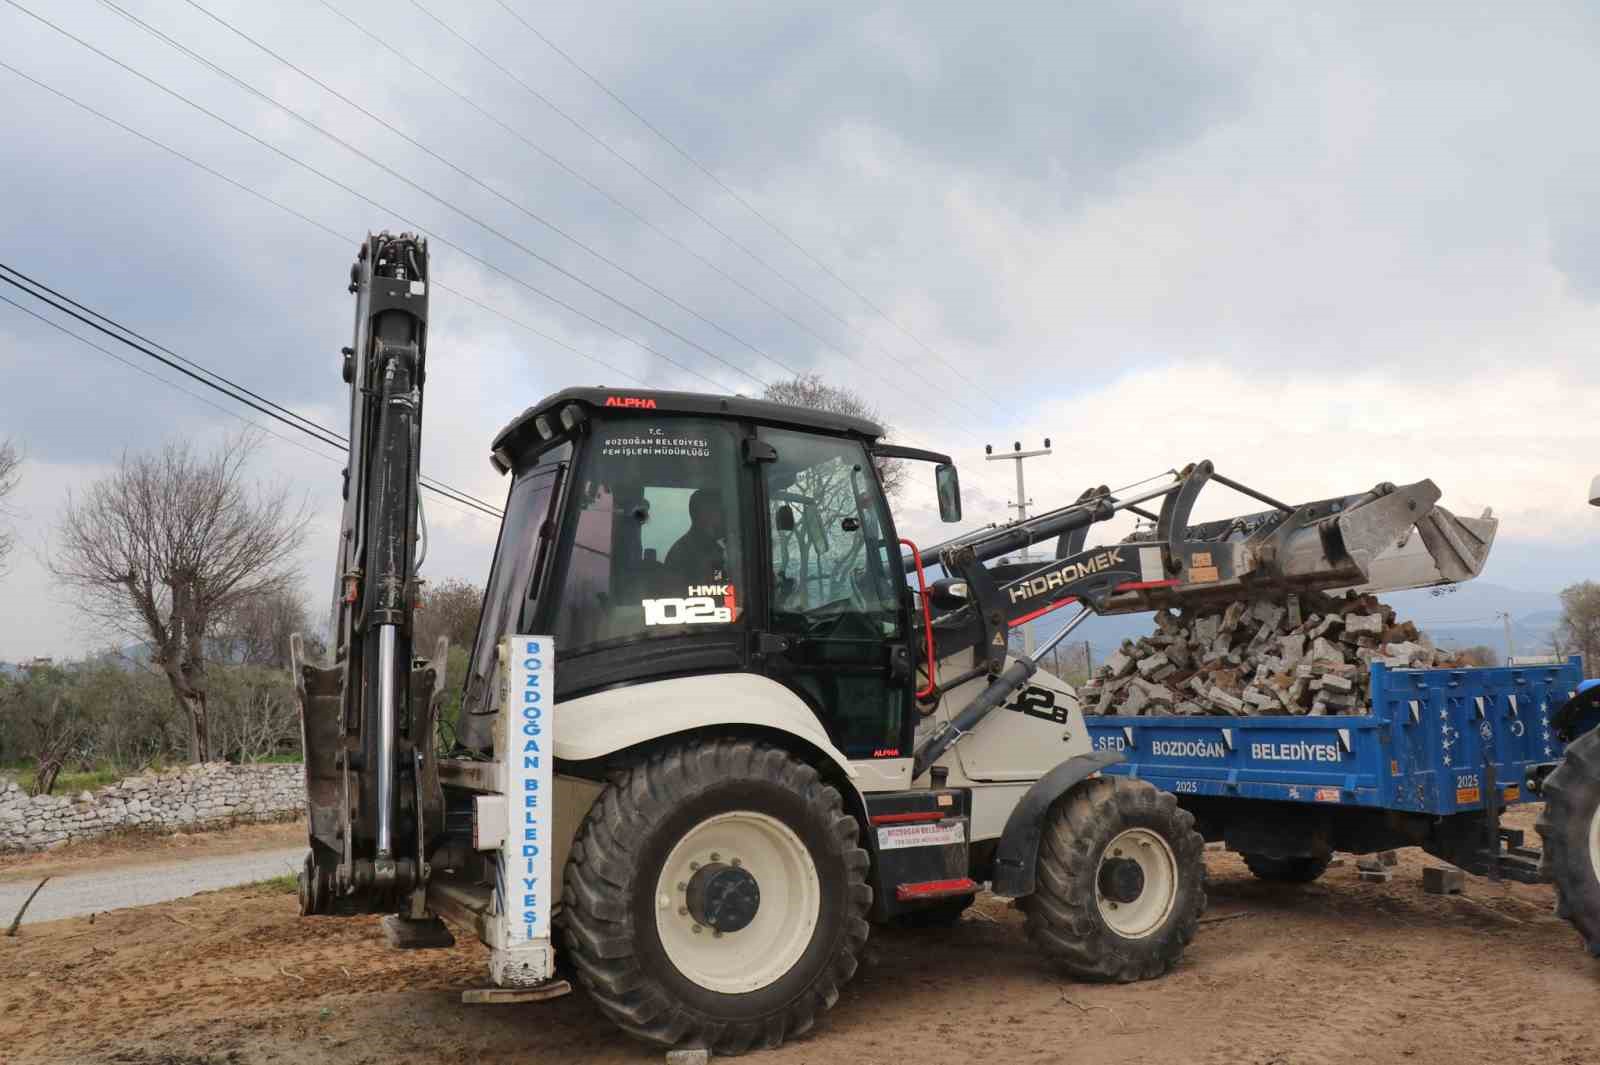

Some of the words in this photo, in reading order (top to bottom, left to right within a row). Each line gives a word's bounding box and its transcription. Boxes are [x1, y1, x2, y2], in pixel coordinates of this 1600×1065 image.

[606, 396, 656, 408] ALPHA
[688, 585, 729, 597] HMK
[523, 642, 542, 769] BOZDOĞAN
[873, 748, 900, 758] ALPHA
[1152, 738, 1226, 758] BOZDOĞAN
[1251, 740, 1342, 762] BELEDİYESİ
[1175, 780, 1198, 793] 2025
[1456, 774, 1480, 788] 2025
[522, 778, 540, 940] BELEDİYESİ
